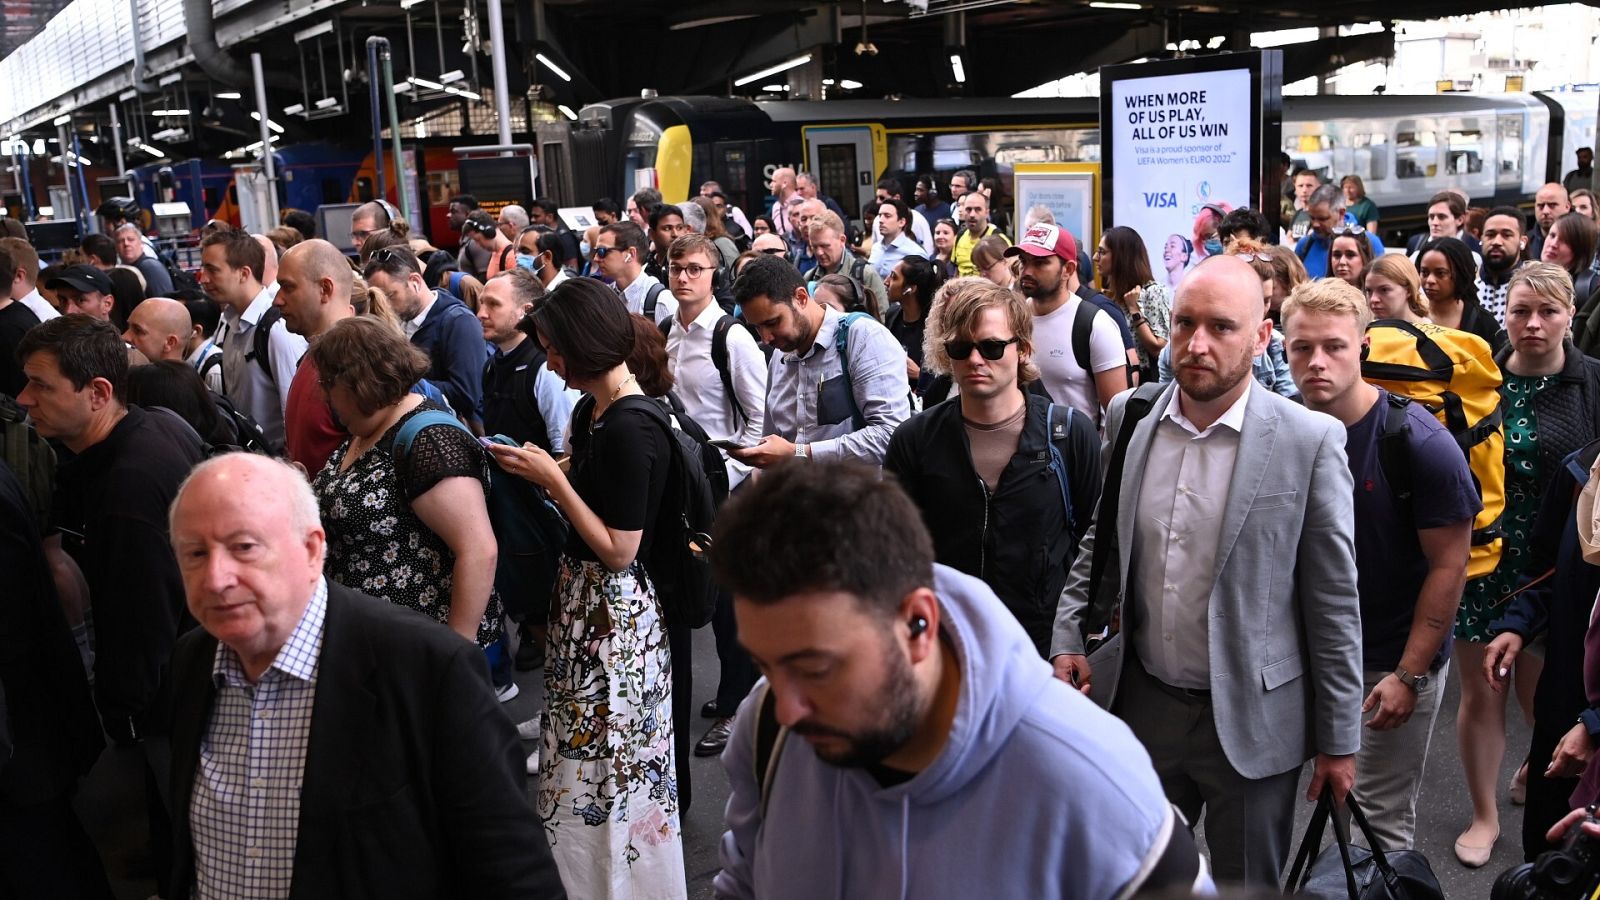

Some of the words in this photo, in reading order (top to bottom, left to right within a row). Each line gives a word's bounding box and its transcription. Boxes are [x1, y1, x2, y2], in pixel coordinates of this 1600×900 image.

[1125, 94, 1164, 108] WHEN
[1167, 90, 1206, 105] MORE
[1129, 111, 1145, 124] OF
[1149, 110, 1165, 123] US
[1169, 108, 1205, 122] PLAY,
[876, 129, 881, 142] 1
[1132, 127, 1155, 140] ALL
[1158, 126, 1175, 139] OF
[1179, 125, 1196, 138] US
[1200, 123, 1228, 137] WIN
[1135, 146, 1149, 154] Visa
[1161, 145, 1182, 154] proud
[1184, 145, 1212, 154] sponsor
[1213, 144, 1222, 152] of
[1137, 157, 1156, 165] UEFA
[1157, 156, 1189, 165] Women's
[1190, 155, 1212, 164] EURO
[863, 172, 868, 184] 1
[1143, 192, 1178, 208] VISA
